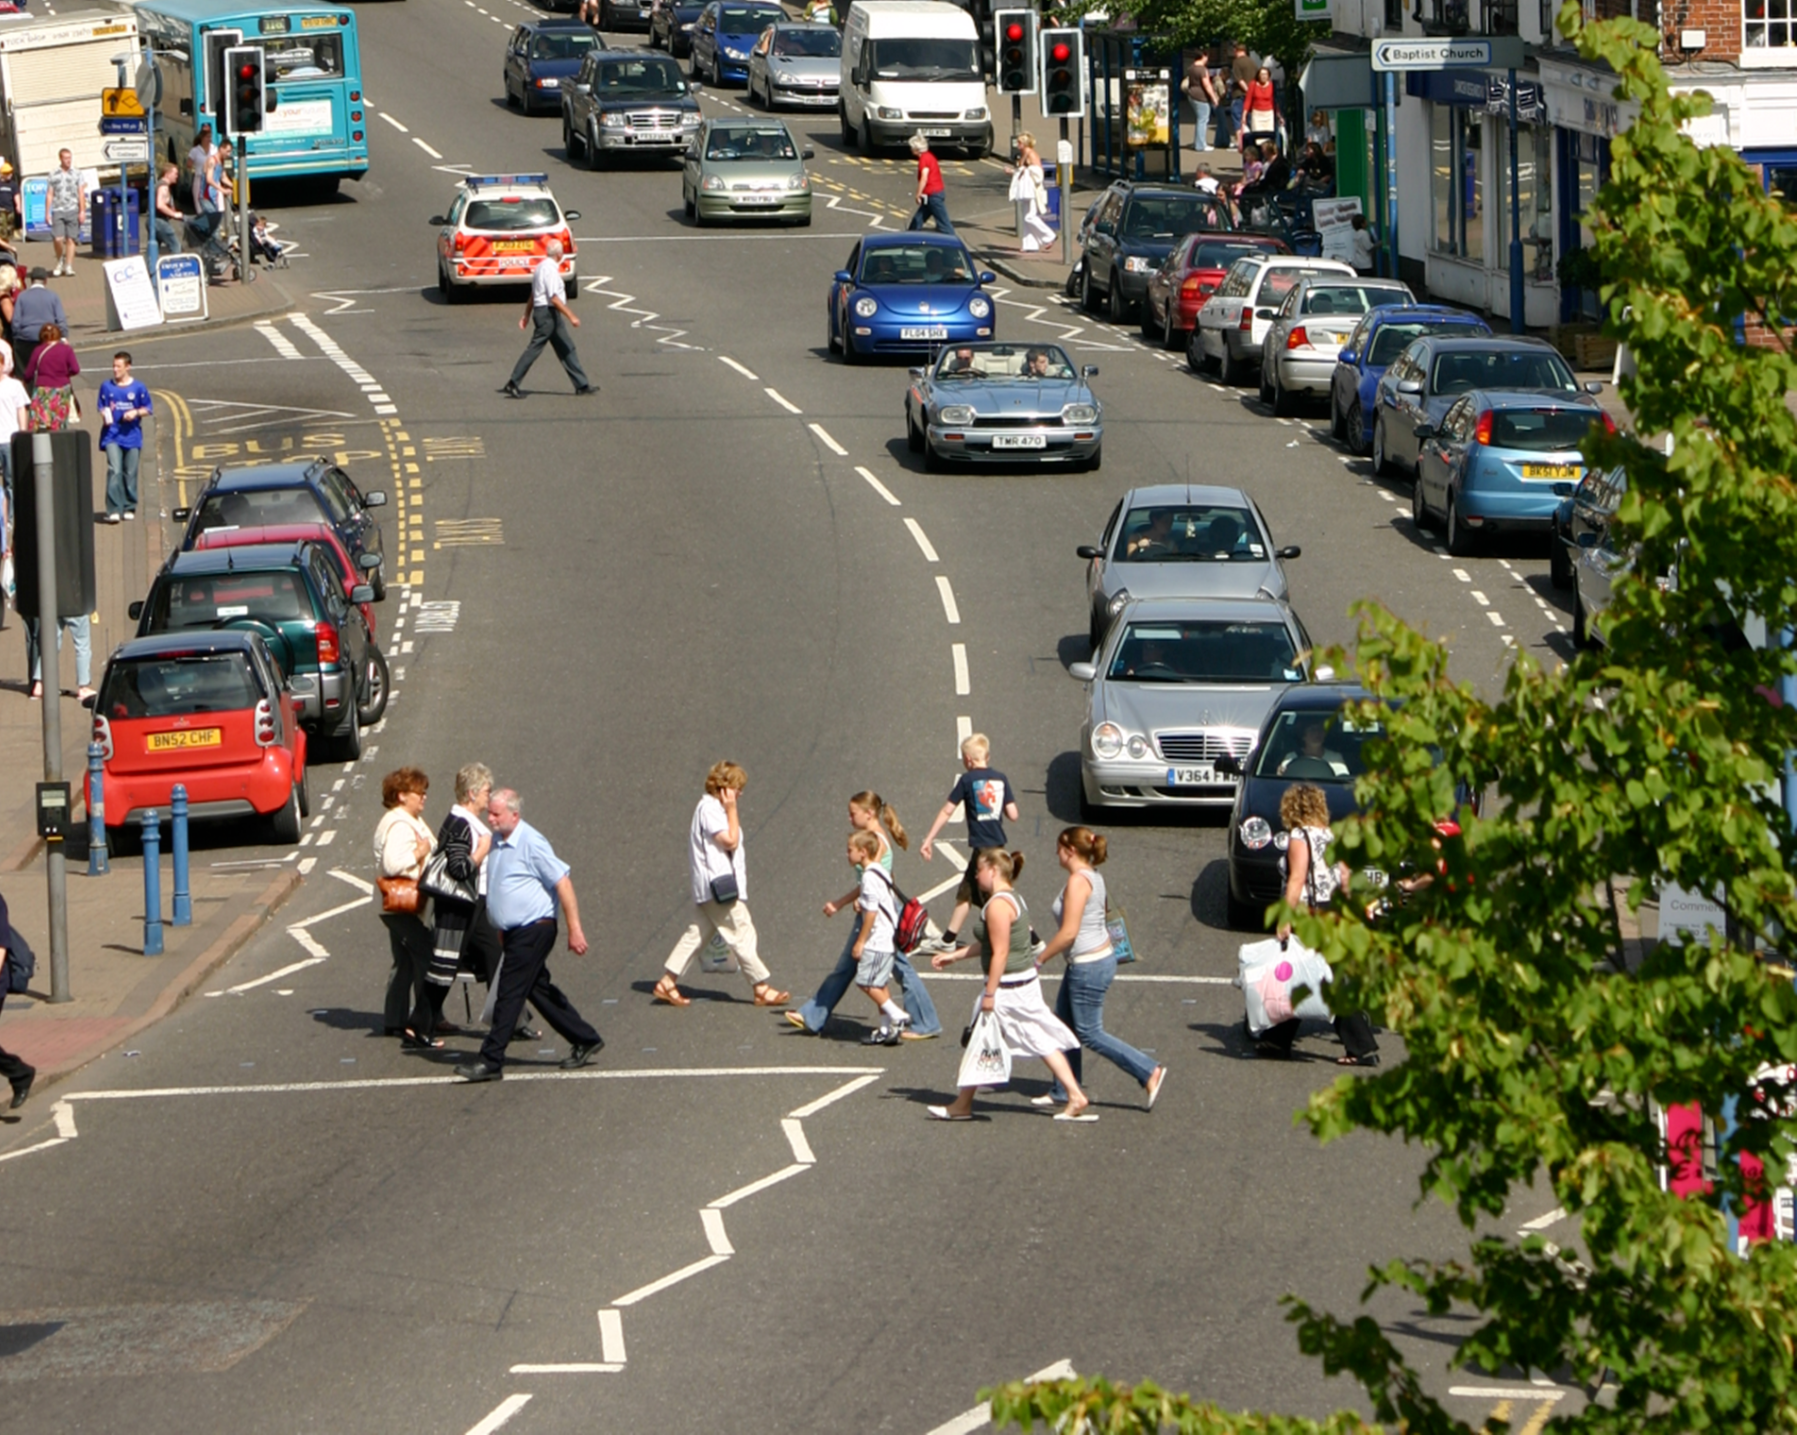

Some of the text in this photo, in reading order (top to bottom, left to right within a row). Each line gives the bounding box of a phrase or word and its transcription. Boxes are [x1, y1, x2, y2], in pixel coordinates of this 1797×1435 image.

[1393, 48, 1484, 60] Baptist Church
[499, 257, 529, 266] POLICE
[192, 433, 346, 460] BUS
[998, 436, 1042, 445] TMR 470
[153, 729, 215, 747] BN52 CHF
[1177, 770, 1210, 782] V364
[1670, 899, 1725, 912] Commer
